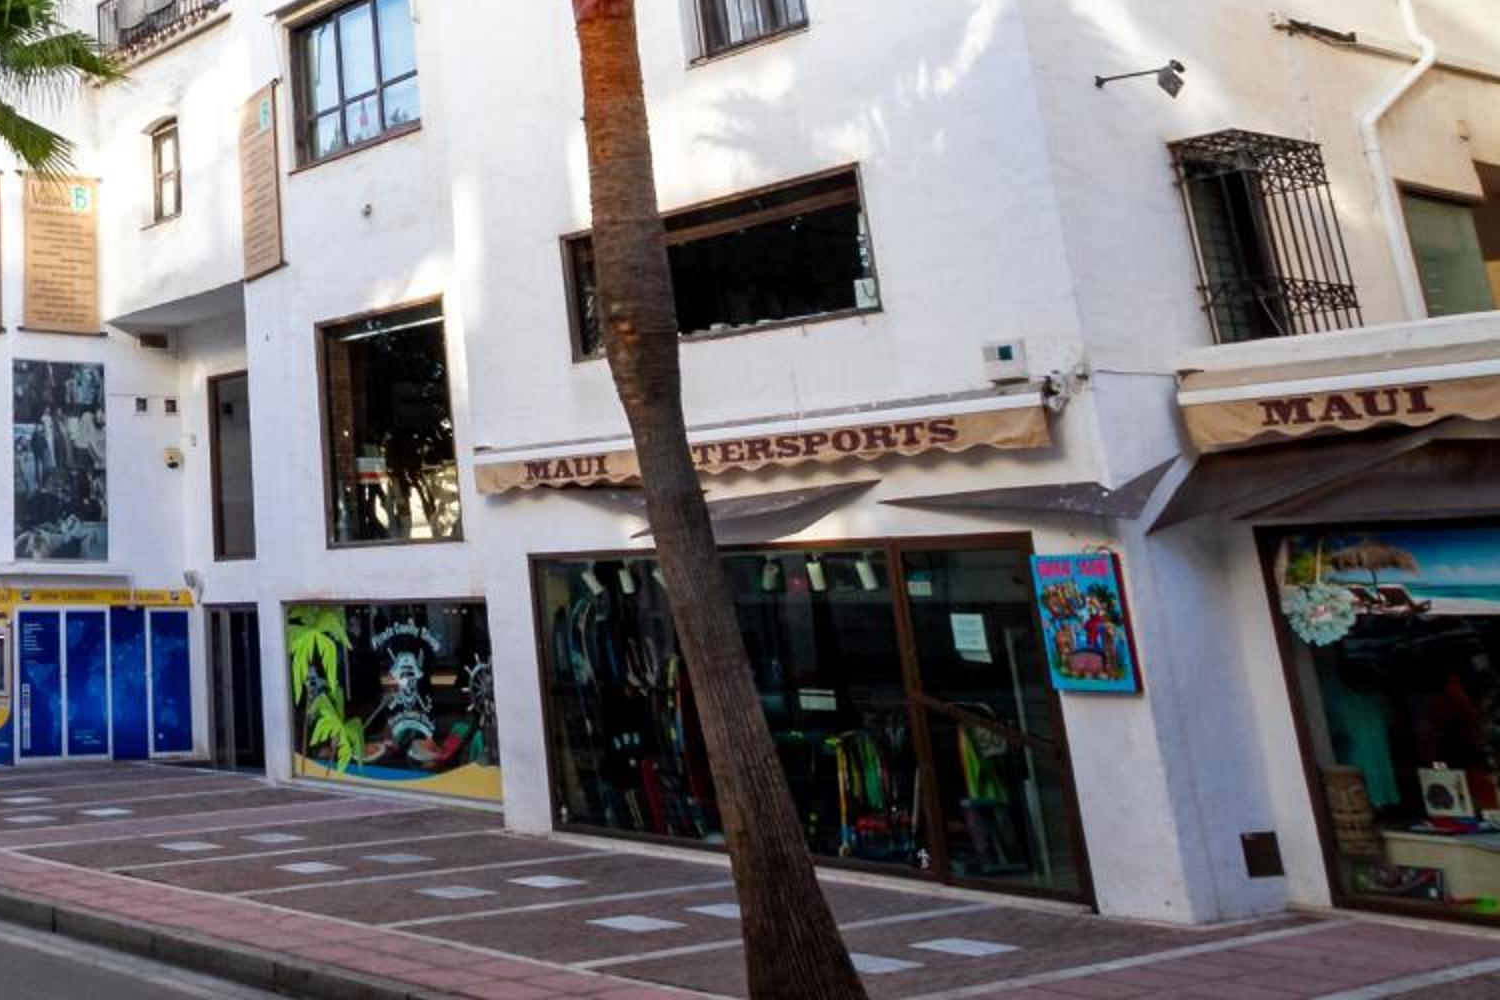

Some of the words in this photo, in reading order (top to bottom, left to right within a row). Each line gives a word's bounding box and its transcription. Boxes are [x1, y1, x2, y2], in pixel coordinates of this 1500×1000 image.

[1258, 385, 1435, 427] MAUI
[524, 455, 610, 481] MAUI
[691, 418, 959, 467] TERSPORTS
